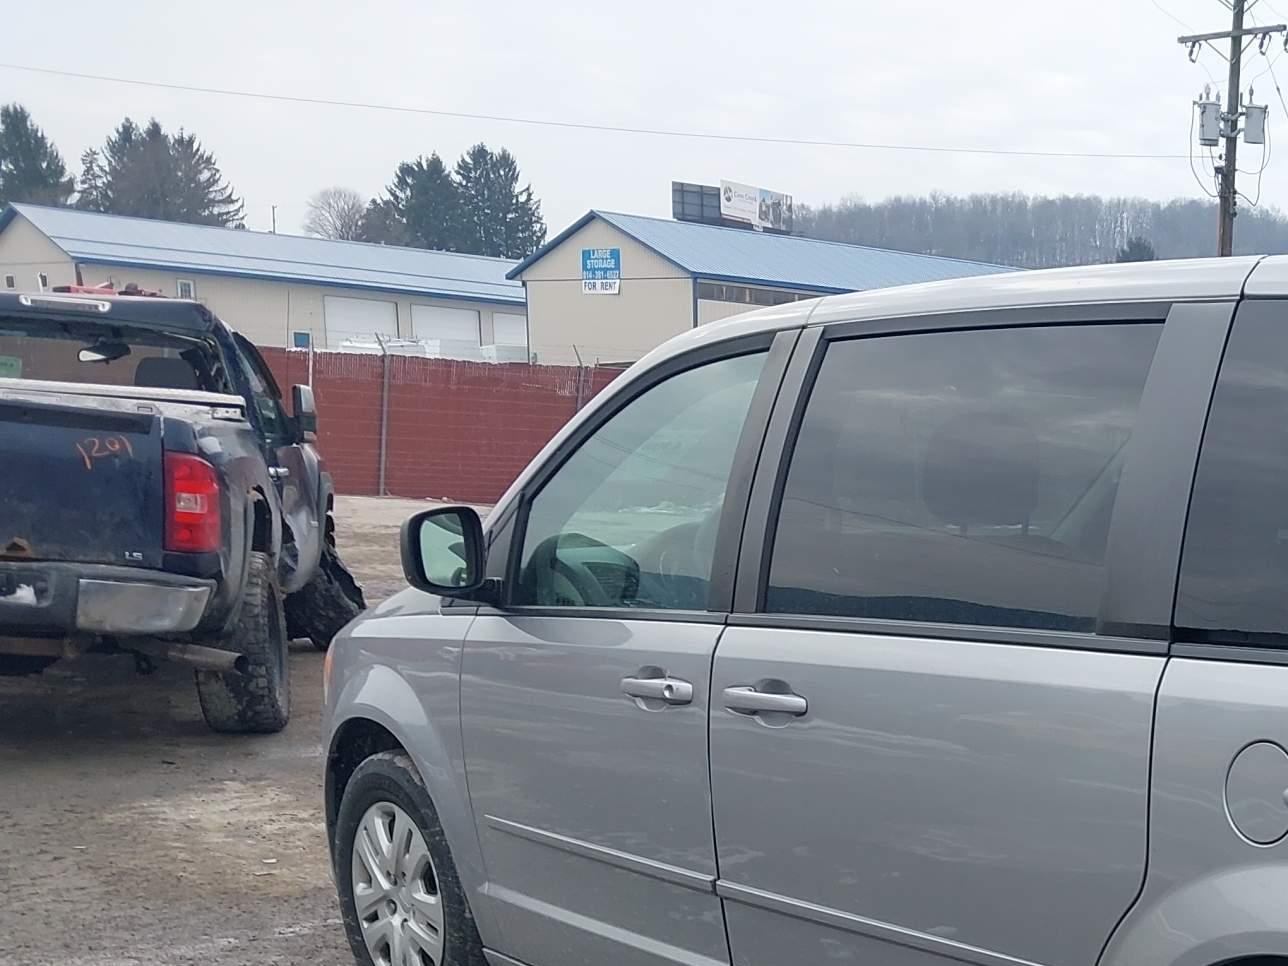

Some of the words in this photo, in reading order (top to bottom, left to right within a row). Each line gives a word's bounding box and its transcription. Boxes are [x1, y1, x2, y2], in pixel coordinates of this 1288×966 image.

[590, 249, 611, 259] LARGE
[586, 258, 616, 269] STORAGE
[583, 281, 597, 291] FOR
[600, 281, 617, 291] RENT
